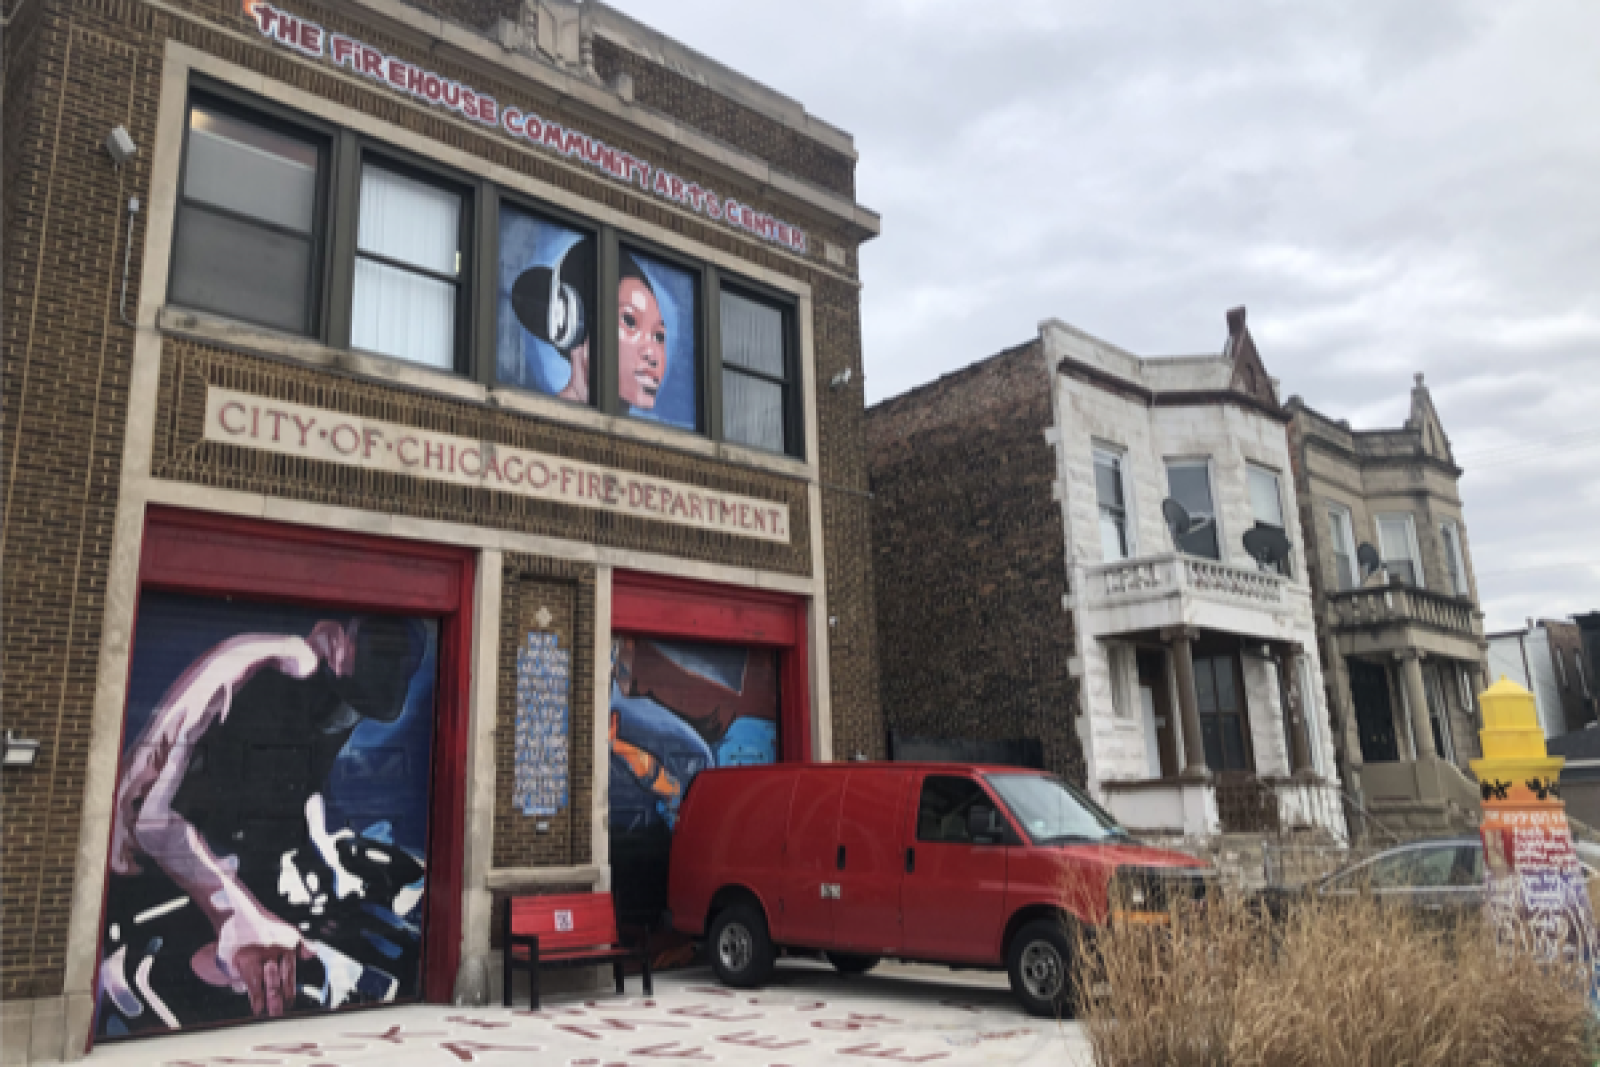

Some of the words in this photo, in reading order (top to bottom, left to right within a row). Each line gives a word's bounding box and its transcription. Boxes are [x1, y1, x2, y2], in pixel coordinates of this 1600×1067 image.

[255, 3, 324, 56] THE
[653, 167, 722, 219] ARTS
[724, 199, 804, 252] CENTER
[218, 401, 316, 447] CITY
[330, 422, 384, 460] OF
[396, 436, 551, 489] CHICAGO
[559, 466, 619, 504] FIRE
